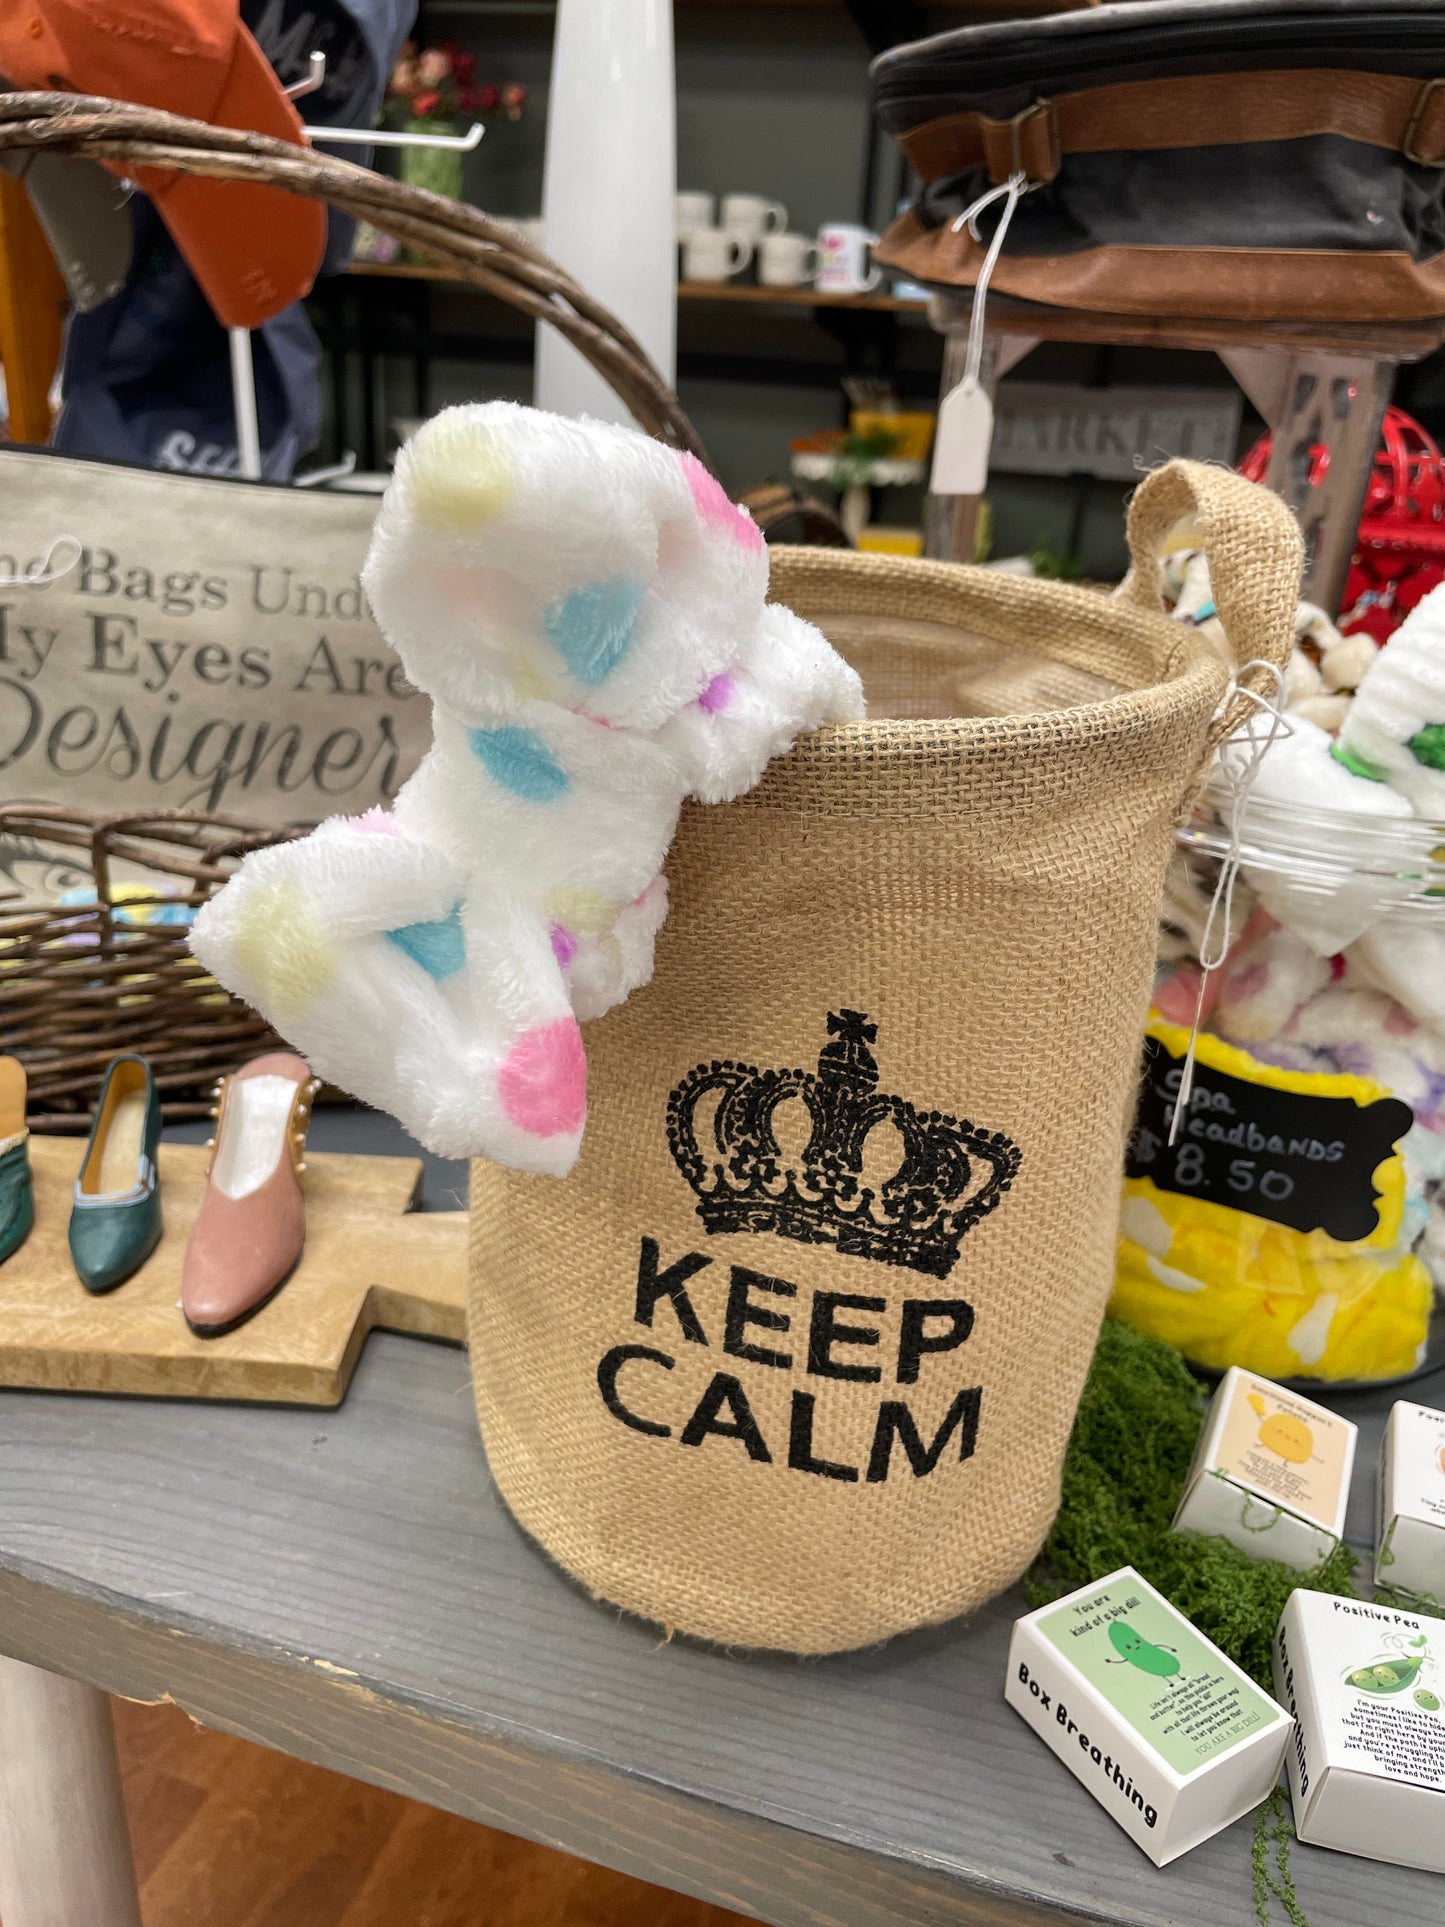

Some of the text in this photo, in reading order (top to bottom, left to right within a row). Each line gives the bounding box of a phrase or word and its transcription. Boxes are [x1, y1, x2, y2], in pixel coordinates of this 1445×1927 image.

[998, 408, 1212, 456] ARKET
[75, 545, 229, 617] Bags
[250, 564, 377, 622] Und
[85, 610, 273, 693] Eyes
[293, 633, 413, 701] Are
[634, 1235, 975, 1385] KEEP
[597, 1343, 983, 1483] CALM
[1073, 1595, 1111, 1615] You are
[1333, 1601, 1420, 1631] Positive Pea
[1069, 1621, 1093, 1637] kind
[1092, 1615, 1104, 1626] of
[1109, 1606, 1127, 1617] big
[1354, 1707, 1397, 1720] sometimes
[1402, 1716, 1416, 1725] like
[1357, 1699, 1369, 1707] I'm
[1391, 1707, 1422, 1719] Positive
[1341, 1718, 1359, 1727] that
[1374, 1726, 1394, 1735] right
[1396, 1729, 1415, 1739] here
[1416, 1734, 1426, 1743] by
[1350, 1712, 1364, 1720] but
[1382, 1720, 1402, 1729] must
[1404, 1725, 1431, 1736] always
[1018, 1662, 1158, 1828] Box Breathing
[1360, 1729, 1374, 1737] And
[1399, 1739, 1418, 1747] path
[1344, 1740, 1360, 1749] just
[1363, 1744, 1383, 1754] think
[1412, 1756, 1426, 1764] and
[1374, 1754, 1408, 1769] bringing
[1392, 1745, 1434, 1761] struggling
[1384, 1764, 1401, 1773] love
